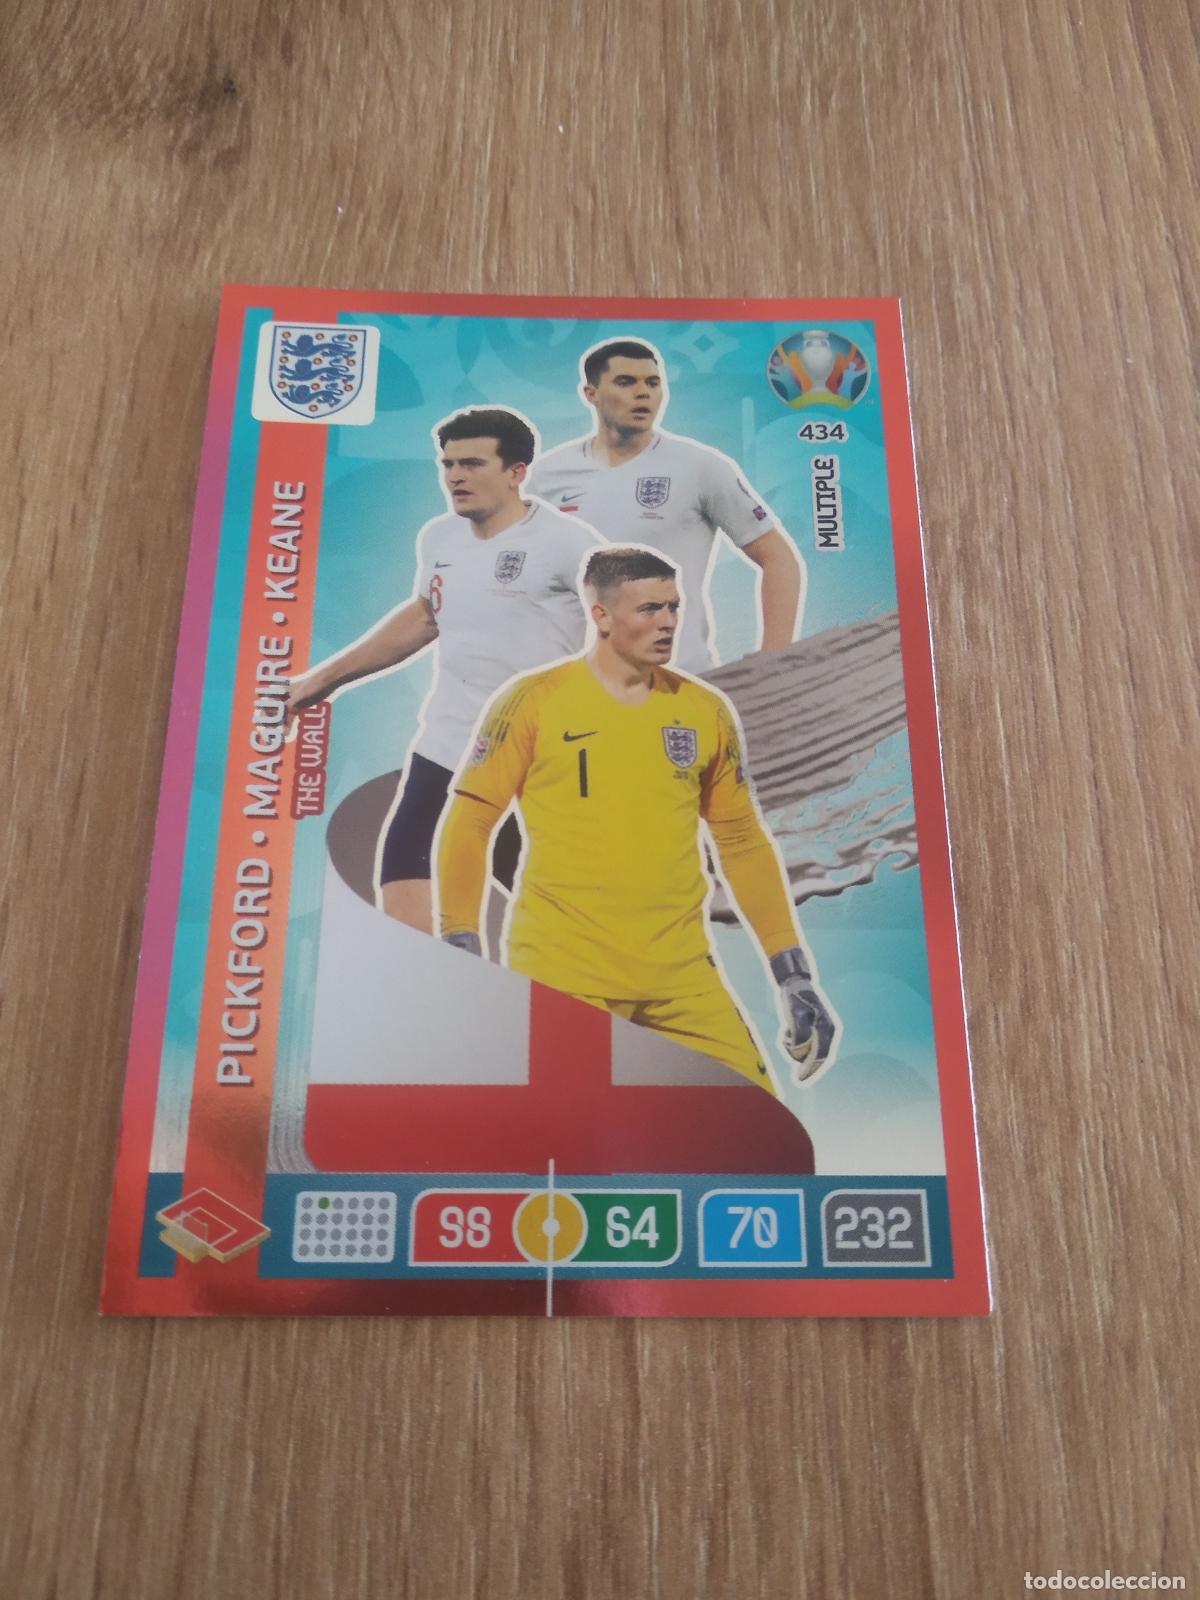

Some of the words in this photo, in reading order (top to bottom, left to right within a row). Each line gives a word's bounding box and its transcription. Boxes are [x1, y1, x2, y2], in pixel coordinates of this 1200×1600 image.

[799, 424, 845, 440] 434
[813, 458, 840, 548] MULTIPLE
[264, 480, 305, 601] KEANE
[243, 634, 292, 817] MAGUIRE
[300, 705, 327, 767] WALL
[296, 772, 322, 815] THE
[579, 748, 588, 798] 1
[216, 856, 273, 1086] PICKFORD
[606, 1206, 660, 1249] 64
[727, 1206, 779, 1249] 70
[834, 1206, 914, 1249] 232
